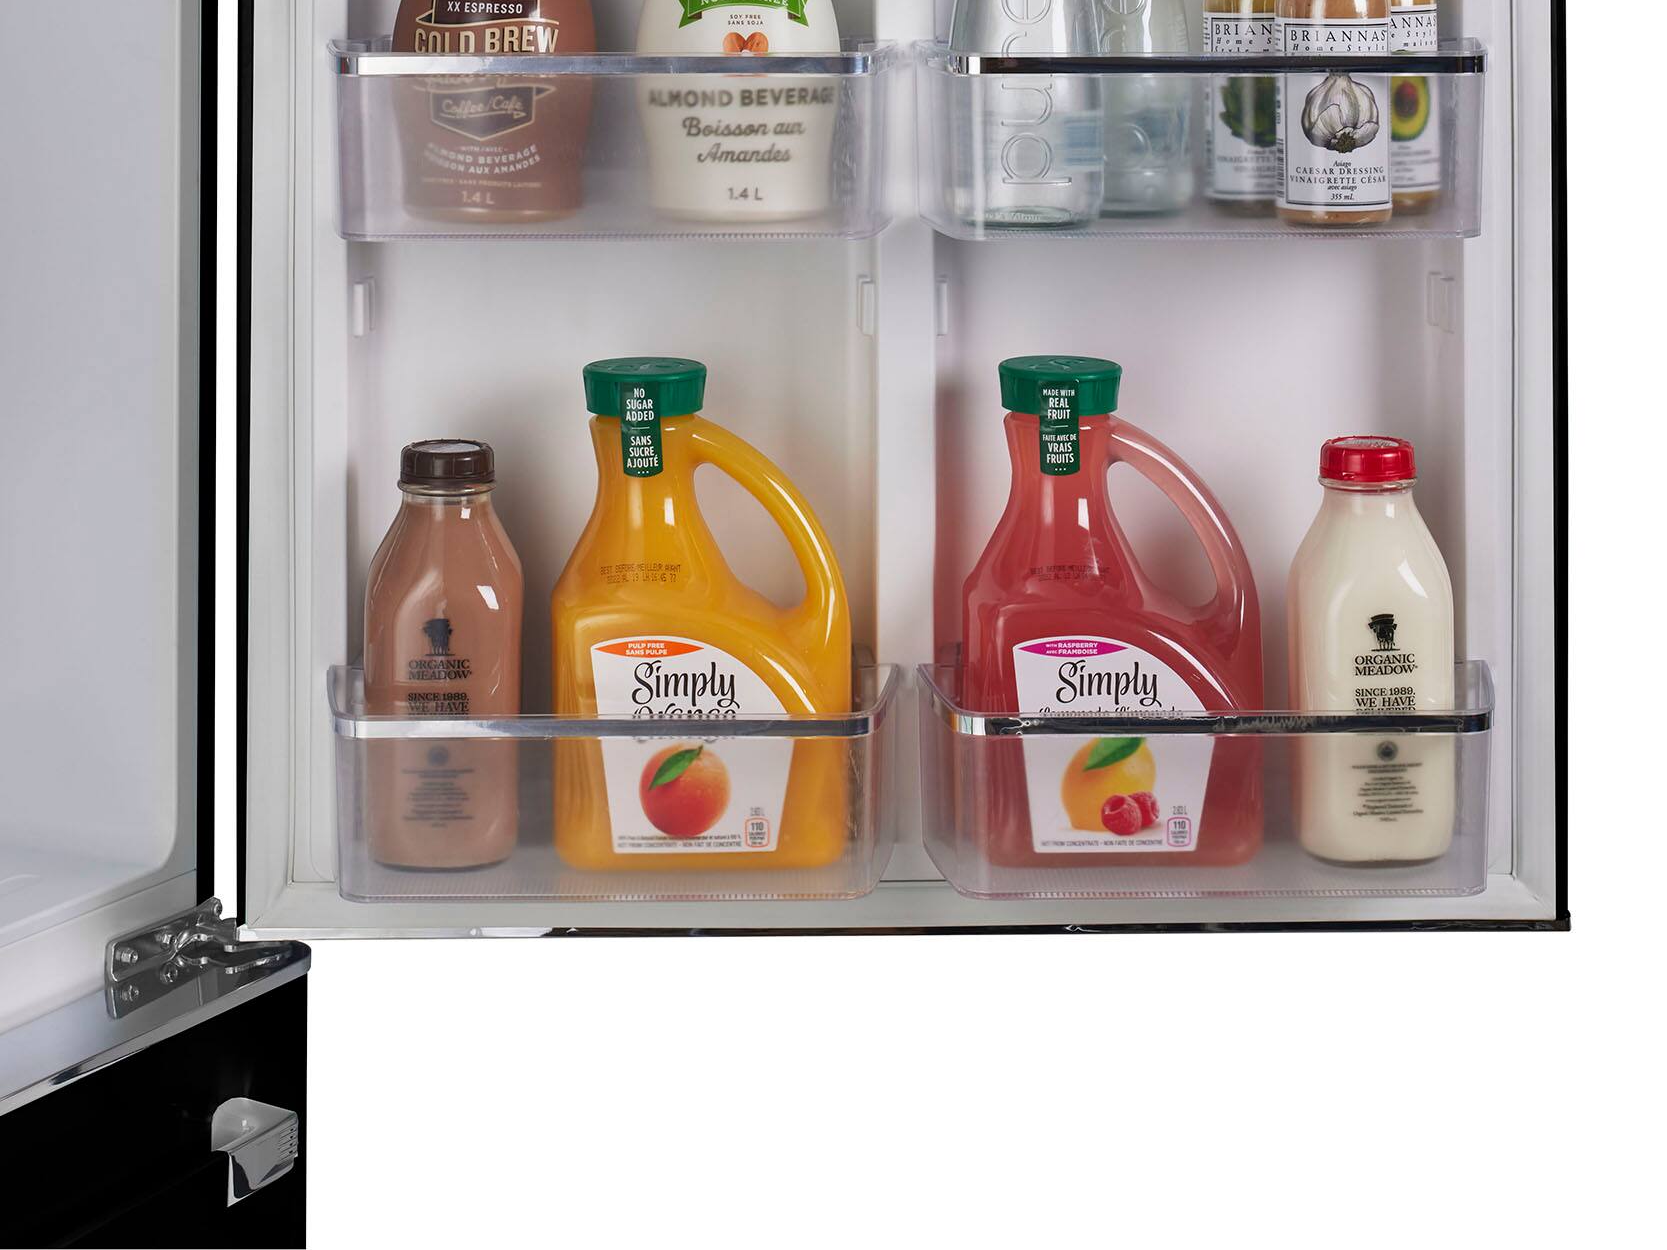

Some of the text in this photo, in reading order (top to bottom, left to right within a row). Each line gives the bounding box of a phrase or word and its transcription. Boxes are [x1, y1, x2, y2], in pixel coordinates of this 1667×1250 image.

[447, 1, 523, 15] XX ESPRESSO
[1215, 24, 1272, 36] BRIAN
[415, 25, 559, 54] COLD BREW
[1290, 30, 1387, 42] BRIANNAS
[1293, 44, 1386, 53] Home Style
[649, 86, 834, 107] ALMOND BEVERAGE
[682, 117, 806, 137] Boisson aux
[478, 144, 537, 164] BEVERAGE
[697, 143, 791, 164] Amandes
[468, 166, 489, 175] AUX
[494, 155, 541, 175] AMANDES
[1333, 160, 1352, 168] Asiago
[1296, 166, 1384, 175] CAESAR DRESSING
[1290, 175, 1386, 184] VINAIGRETTE CÉSAR
[462, 191, 495, 204] 1.4 L
[728, 187, 763, 200] 1.4 L
[634, 388, 645, 398] NO
[1043, 389, 1075, 397] MADE WITH
[626, 399, 653, 410] SUGAR
[1049, 397, 1070, 408] REAL
[626, 411, 655, 422] ADDED
[1047, 409, 1071, 420] FRUIT
[630, 436, 652, 446] SANS
[1042, 434, 1057, 442] FAITE
[629, 446, 654, 457] SUCRE
[1047, 442, 1073, 453] VRAIS
[626, 454, 659, 468] AJOUTÉ
[1046, 453, 1075, 464] FRUITS
[408, 659, 470, 670] ORGANIC
[1354, 653, 1415, 665] ORGANIC
[408, 669, 470, 681] MEADOW
[1354, 665, 1415, 676] MEADOW
[631, 660, 741, 709] Simply
[1056, 659, 1162, 708] Simply
[408, 692, 440, 702] SINCE
[1355, 687, 1416, 697] SINCE 1989.
[408, 702, 469, 712] WE HAVE
[1356, 696, 1416, 708] WE HAVE
[750, 822, 764, 831] 110
[1174, 821, 1186, 830] 110
